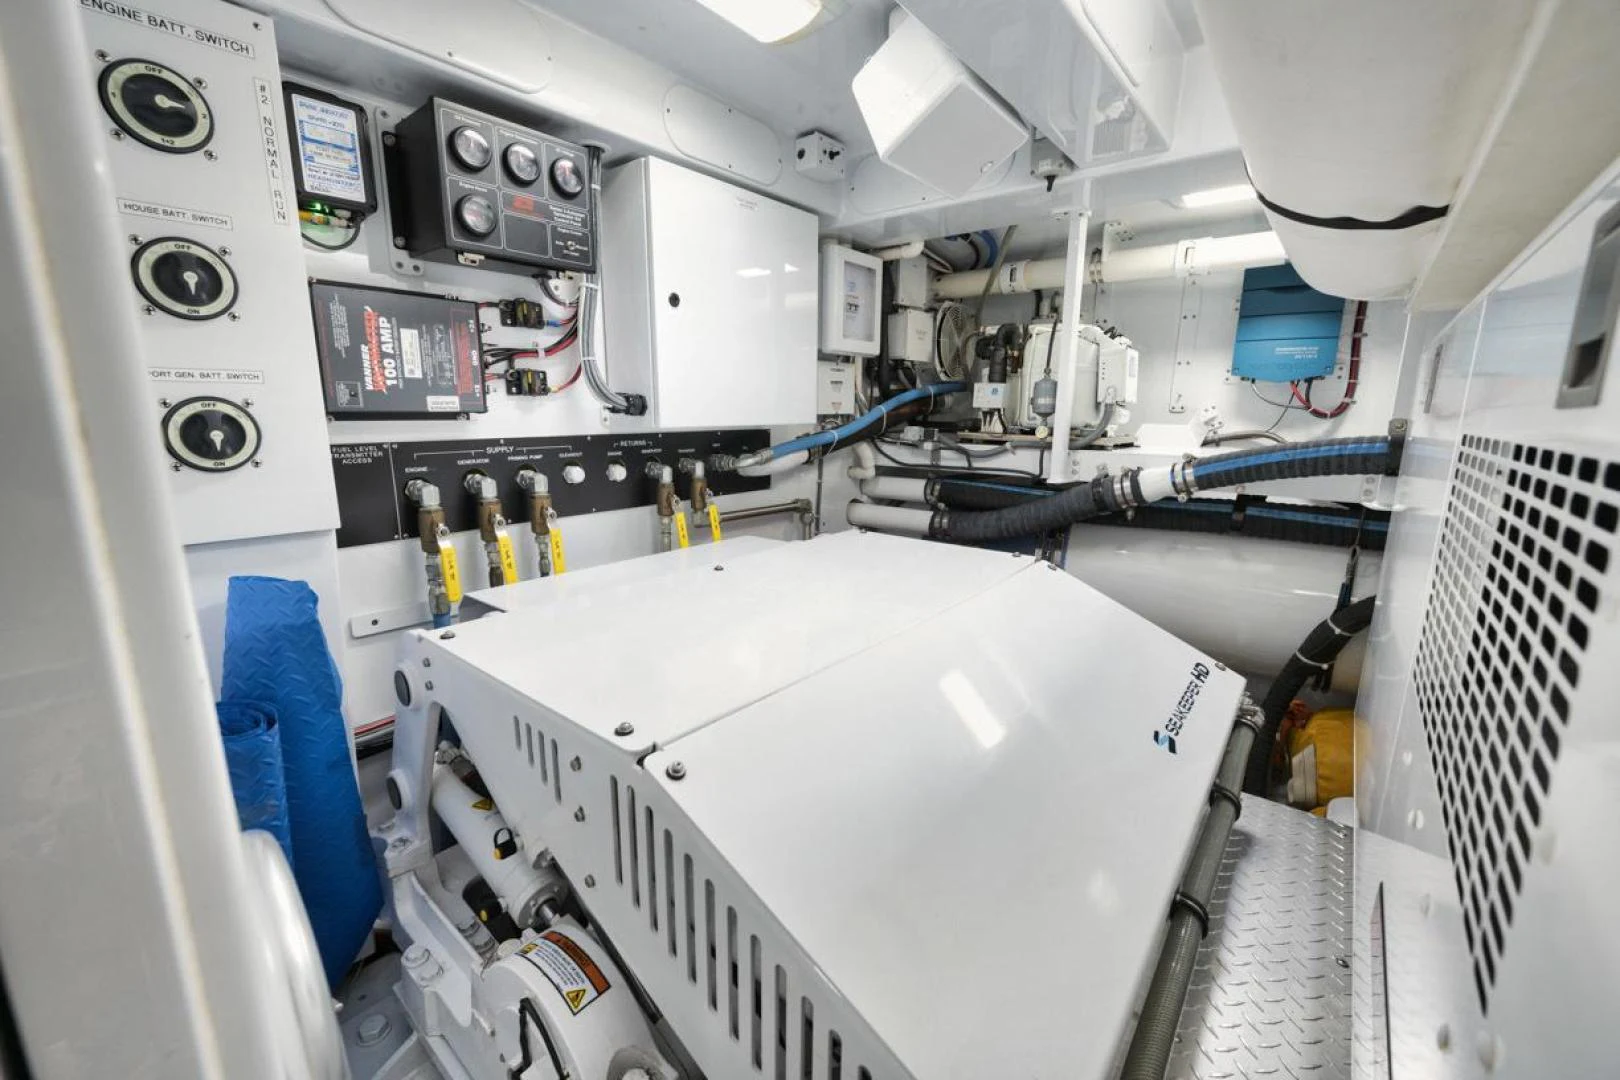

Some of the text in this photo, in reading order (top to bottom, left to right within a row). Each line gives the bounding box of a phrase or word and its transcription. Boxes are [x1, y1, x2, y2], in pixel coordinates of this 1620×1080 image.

[81, 0, 249, 54] ENGINE BATT. SWITCH
[145, 65, 162, 74] OFF
[263, 116, 279, 180] NORMAL
[274, 190, 286, 220] RUN
[123, 203, 160, 214] HOUSE
[191, 214, 228, 226] SWITCH
[379, 316, 395, 353] AMP
[360, 344, 373, 390] VANNER
[383, 358, 398, 385] 100
[486, 446, 514, 454] SUPPLY
[1165, 662, 1210, 736] SEAKEEPER HD
